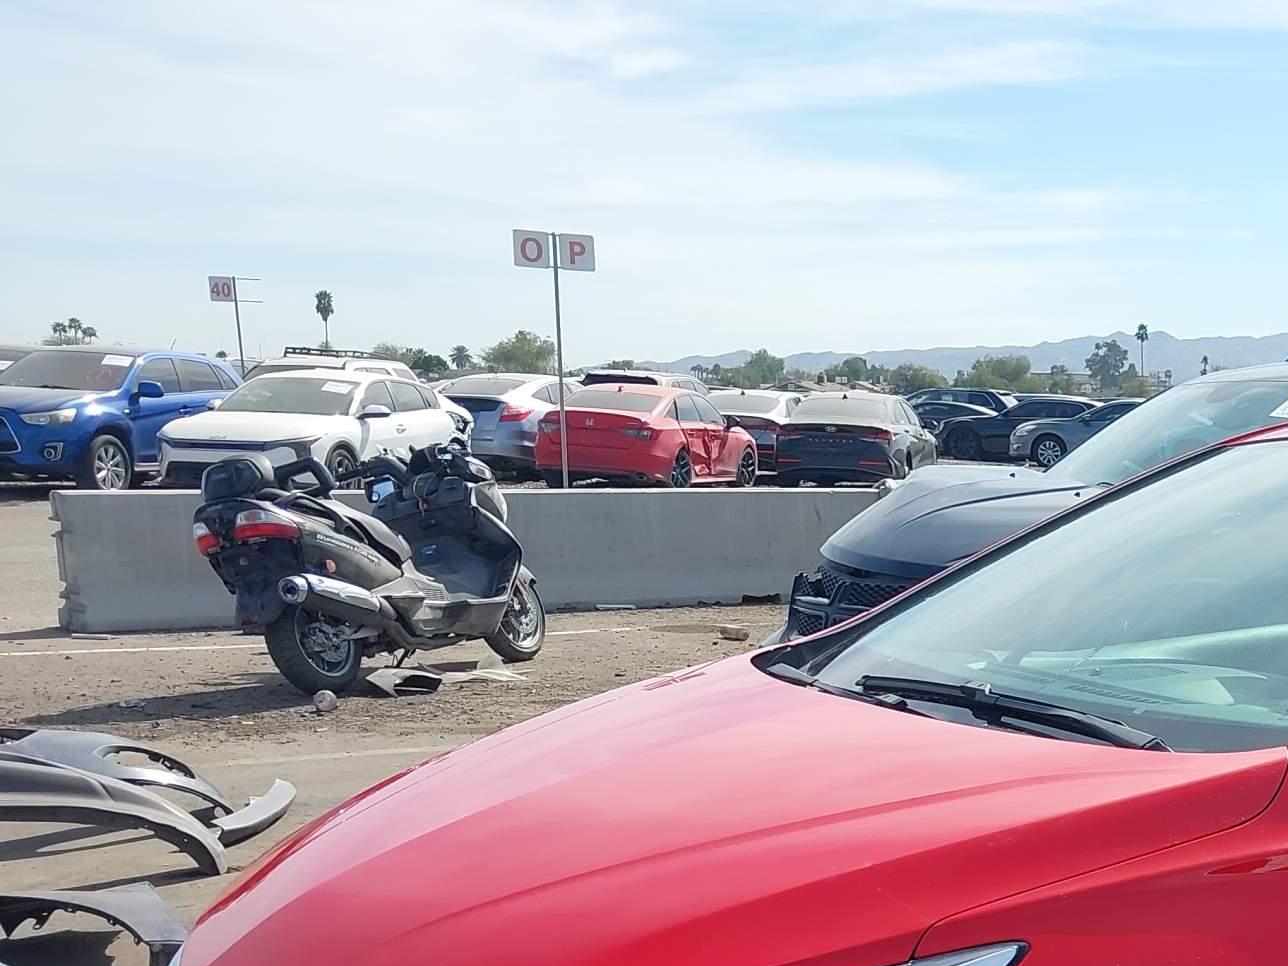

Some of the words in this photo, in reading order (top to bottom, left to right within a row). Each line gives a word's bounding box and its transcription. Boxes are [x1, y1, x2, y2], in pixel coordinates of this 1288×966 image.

[520, 237, 543, 263] O
[568, 240, 586, 265] P
[211, 282, 231, 298] 40
